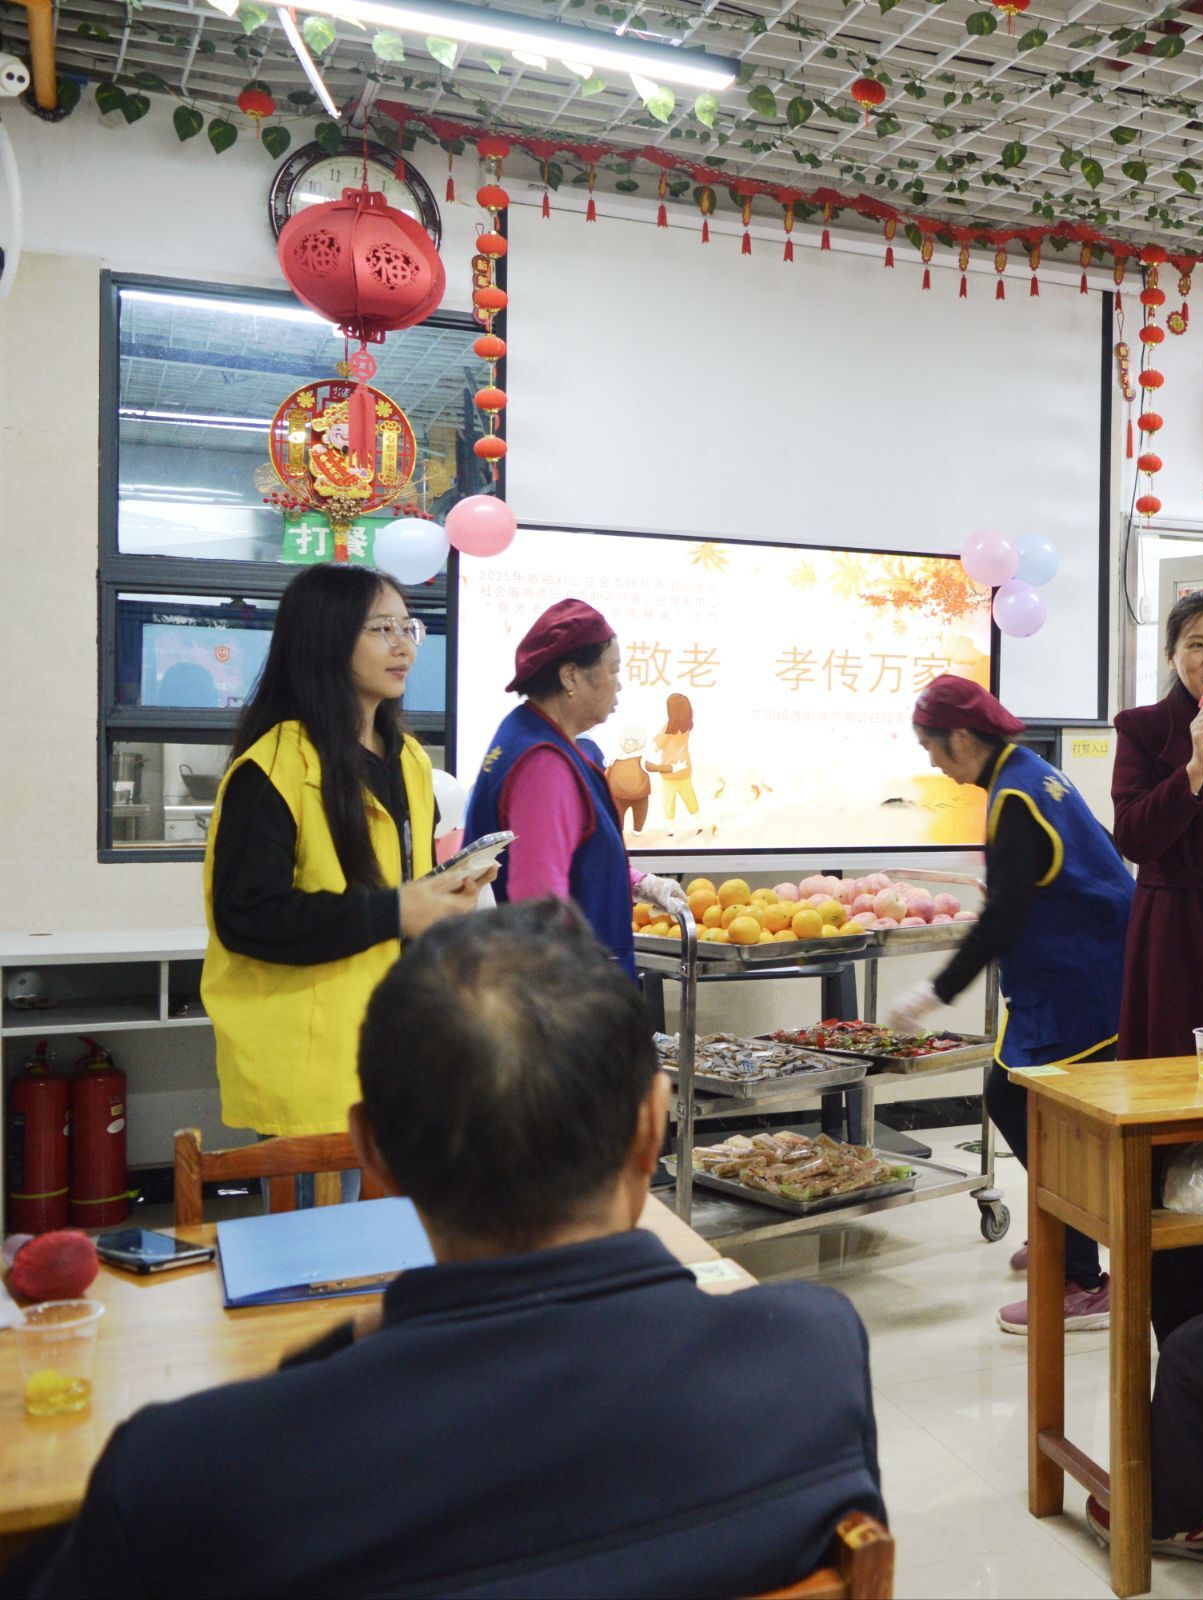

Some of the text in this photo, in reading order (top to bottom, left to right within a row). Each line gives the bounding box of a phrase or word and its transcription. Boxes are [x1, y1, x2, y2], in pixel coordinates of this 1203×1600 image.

[329, 168, 341, 183] 11
[288, 522, 384, 558] 打餐
[625, 640, 951, 693] 敬老 孝传万家
